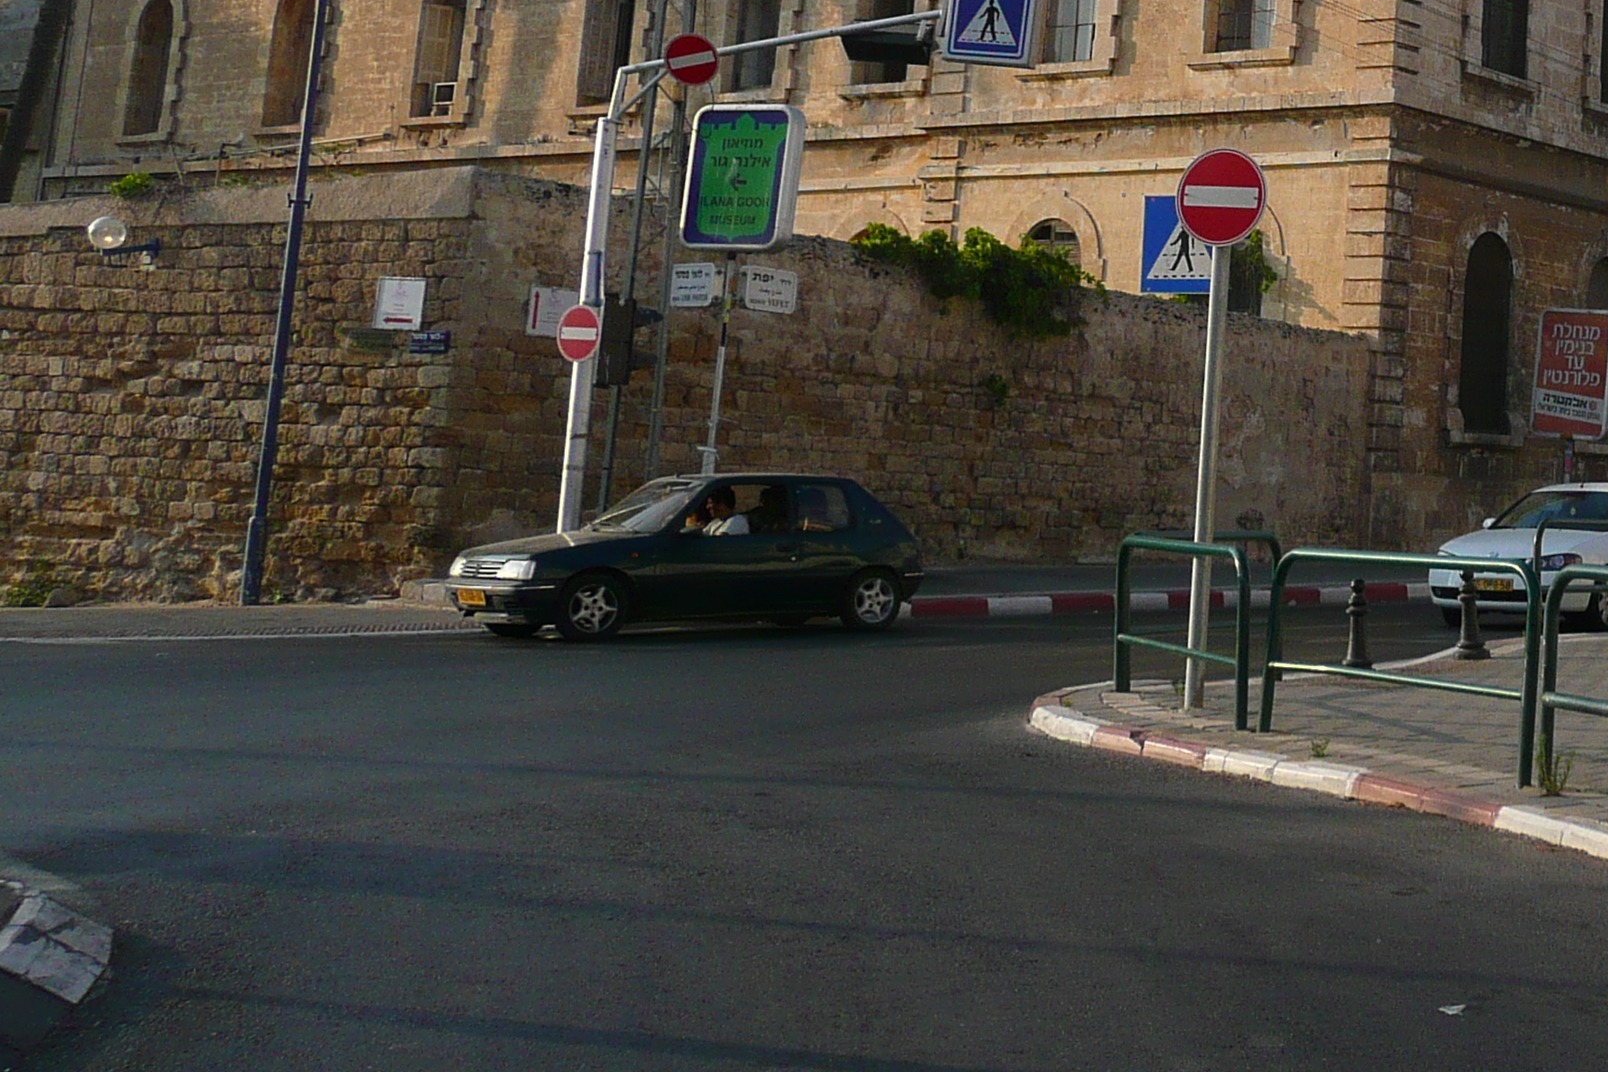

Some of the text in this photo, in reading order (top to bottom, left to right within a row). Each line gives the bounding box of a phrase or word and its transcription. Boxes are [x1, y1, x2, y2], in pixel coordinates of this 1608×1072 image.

[722, 137, 763, 151] מוזיאון
[711, 156, 728, 167] גור
[700, 196, 733, 207] ILANA
[709, 214, 756, 225] MUSEUM
[752, 272, 774, 283] יפת
[1551, 322, 1601, 341] מנחלת
[1555, 339, 1594, 356] בנימין
[1564, 355, 1585, 370] עד
[1542, 368, 1601, 387] פלורנטין
[1543, 392, 1588, 409] אלקטרה
